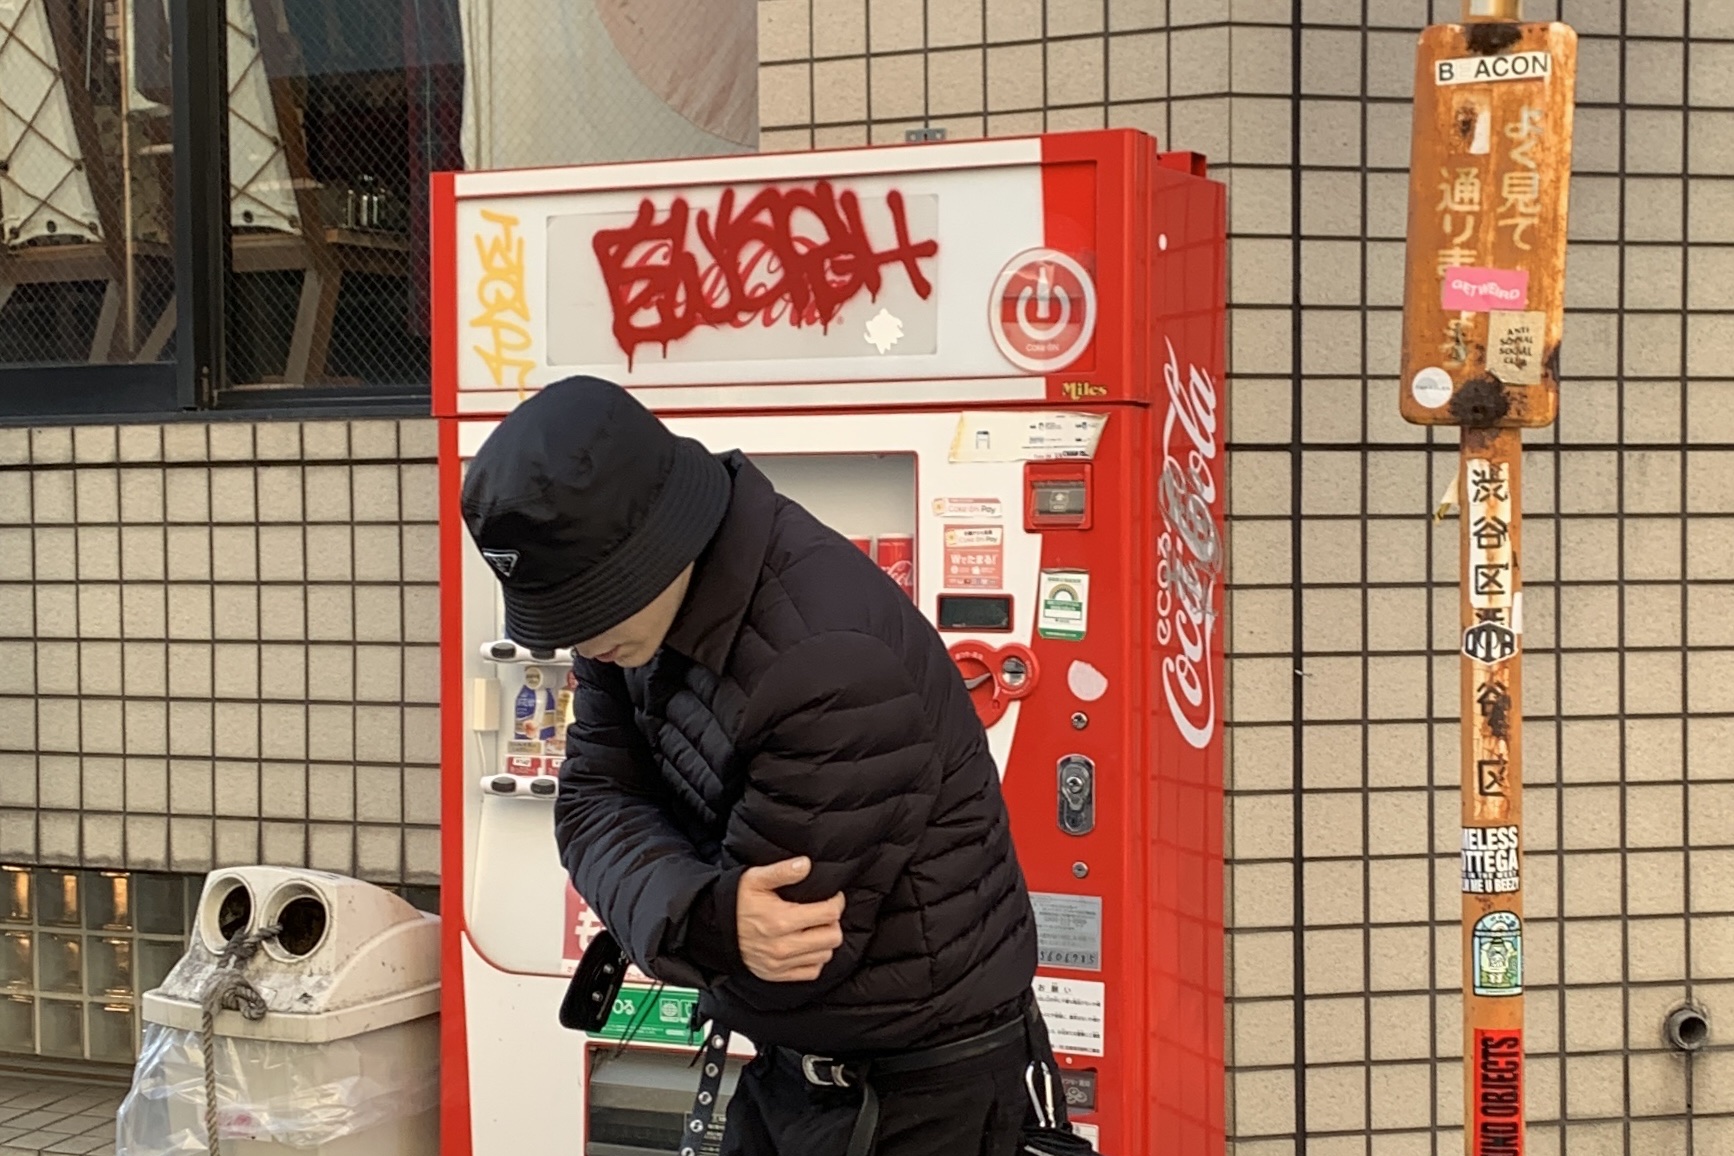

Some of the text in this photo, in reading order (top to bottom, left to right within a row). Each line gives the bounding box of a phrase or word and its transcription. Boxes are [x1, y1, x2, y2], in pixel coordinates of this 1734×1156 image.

[1452, 279, 1520, 300] GET WEIRD
[1507, 327, 1530, 336] ANTI
[1062, 382, 1108, 400] Miles
[1462, 826, 1519, 851] ELESS
[1480, 1036, 1519, 1117] OBJECTS
